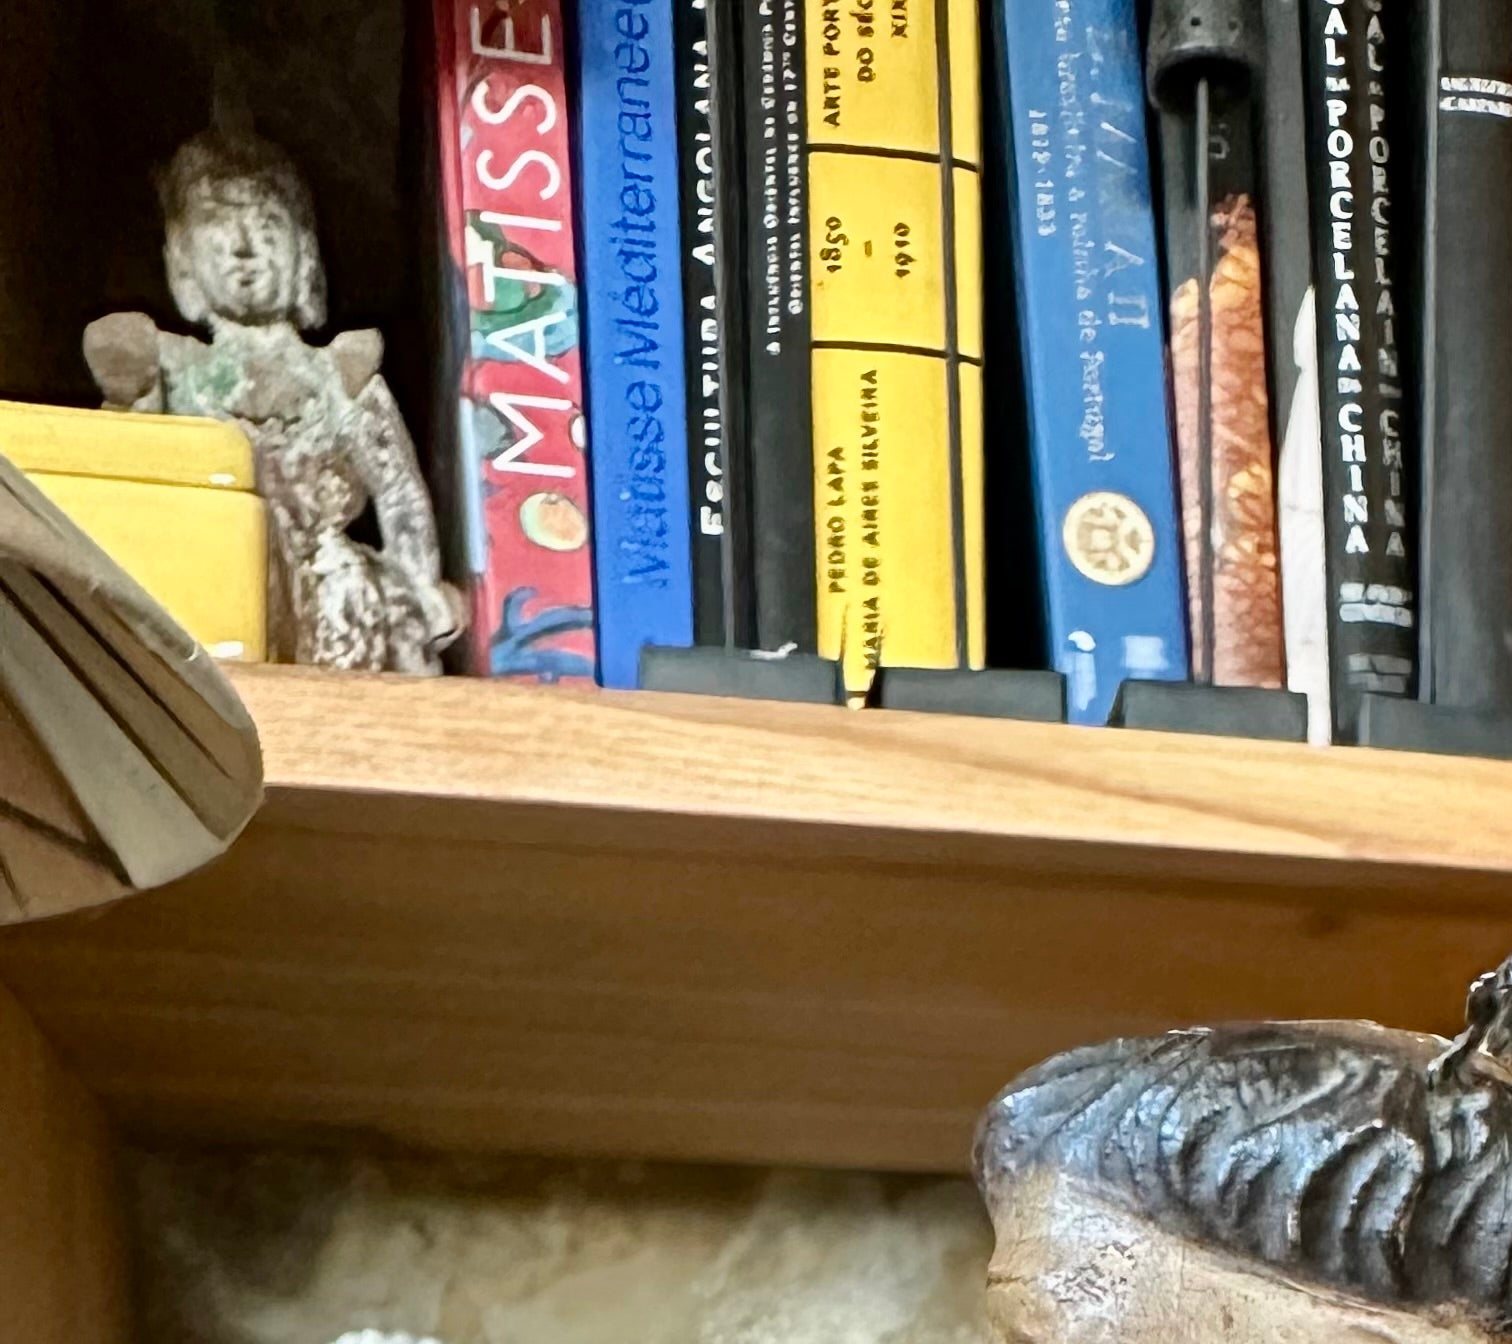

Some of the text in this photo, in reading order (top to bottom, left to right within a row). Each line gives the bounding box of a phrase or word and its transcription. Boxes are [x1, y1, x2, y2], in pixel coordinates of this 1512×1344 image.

[1323, 0, 1348, 66] AL
[470, 6, 577, 478] MATISSE
[819, 216, 849, 274] 1850
[892, 222, 917, 278] 1910
[1326, 99, 1362, 371] PORCELANA
[1078, 310, 1103, 343] de
[1079, 350, 1116, 462] Portugal
[1338, 402, 1370, 554] CHINA
[614, 380, 671, 592] Matisse
[826, 446, 847, 594] PEDRO LAPA
[1379, 409, 1405, 557] CHINA
